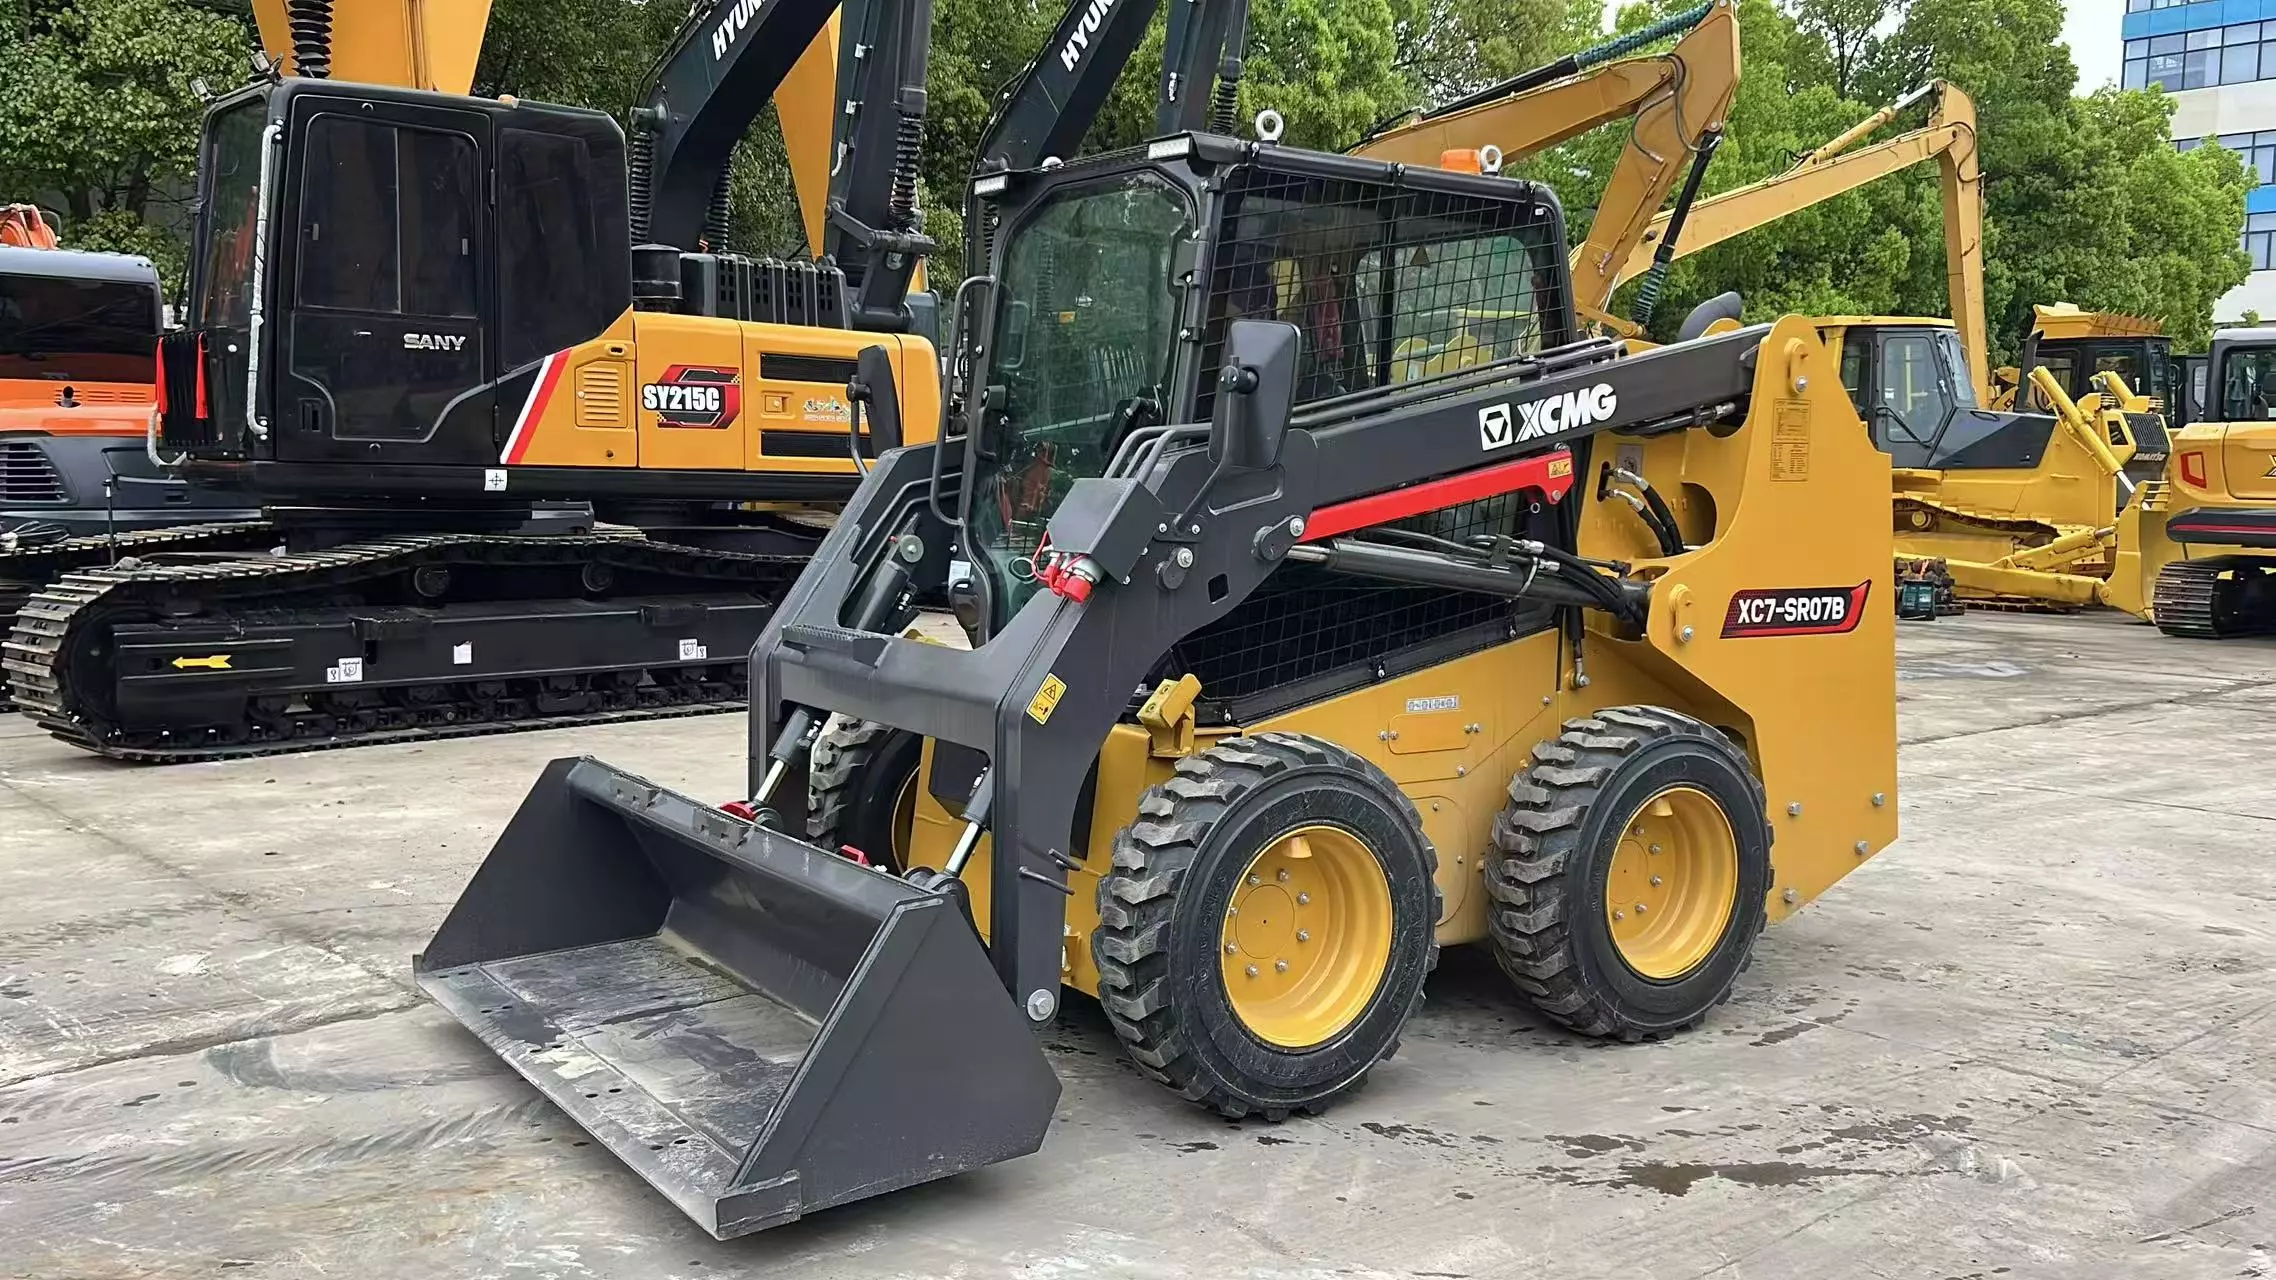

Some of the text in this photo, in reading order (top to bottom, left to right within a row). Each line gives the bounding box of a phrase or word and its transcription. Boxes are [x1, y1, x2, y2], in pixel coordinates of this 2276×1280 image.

[403, 333, 466, 351] SANY
[643, 384, 720, 411] SY215C
[1514, 383, 1617, 443] XCMG
[1737, 596, 1845, 624] XC7-SR07B
